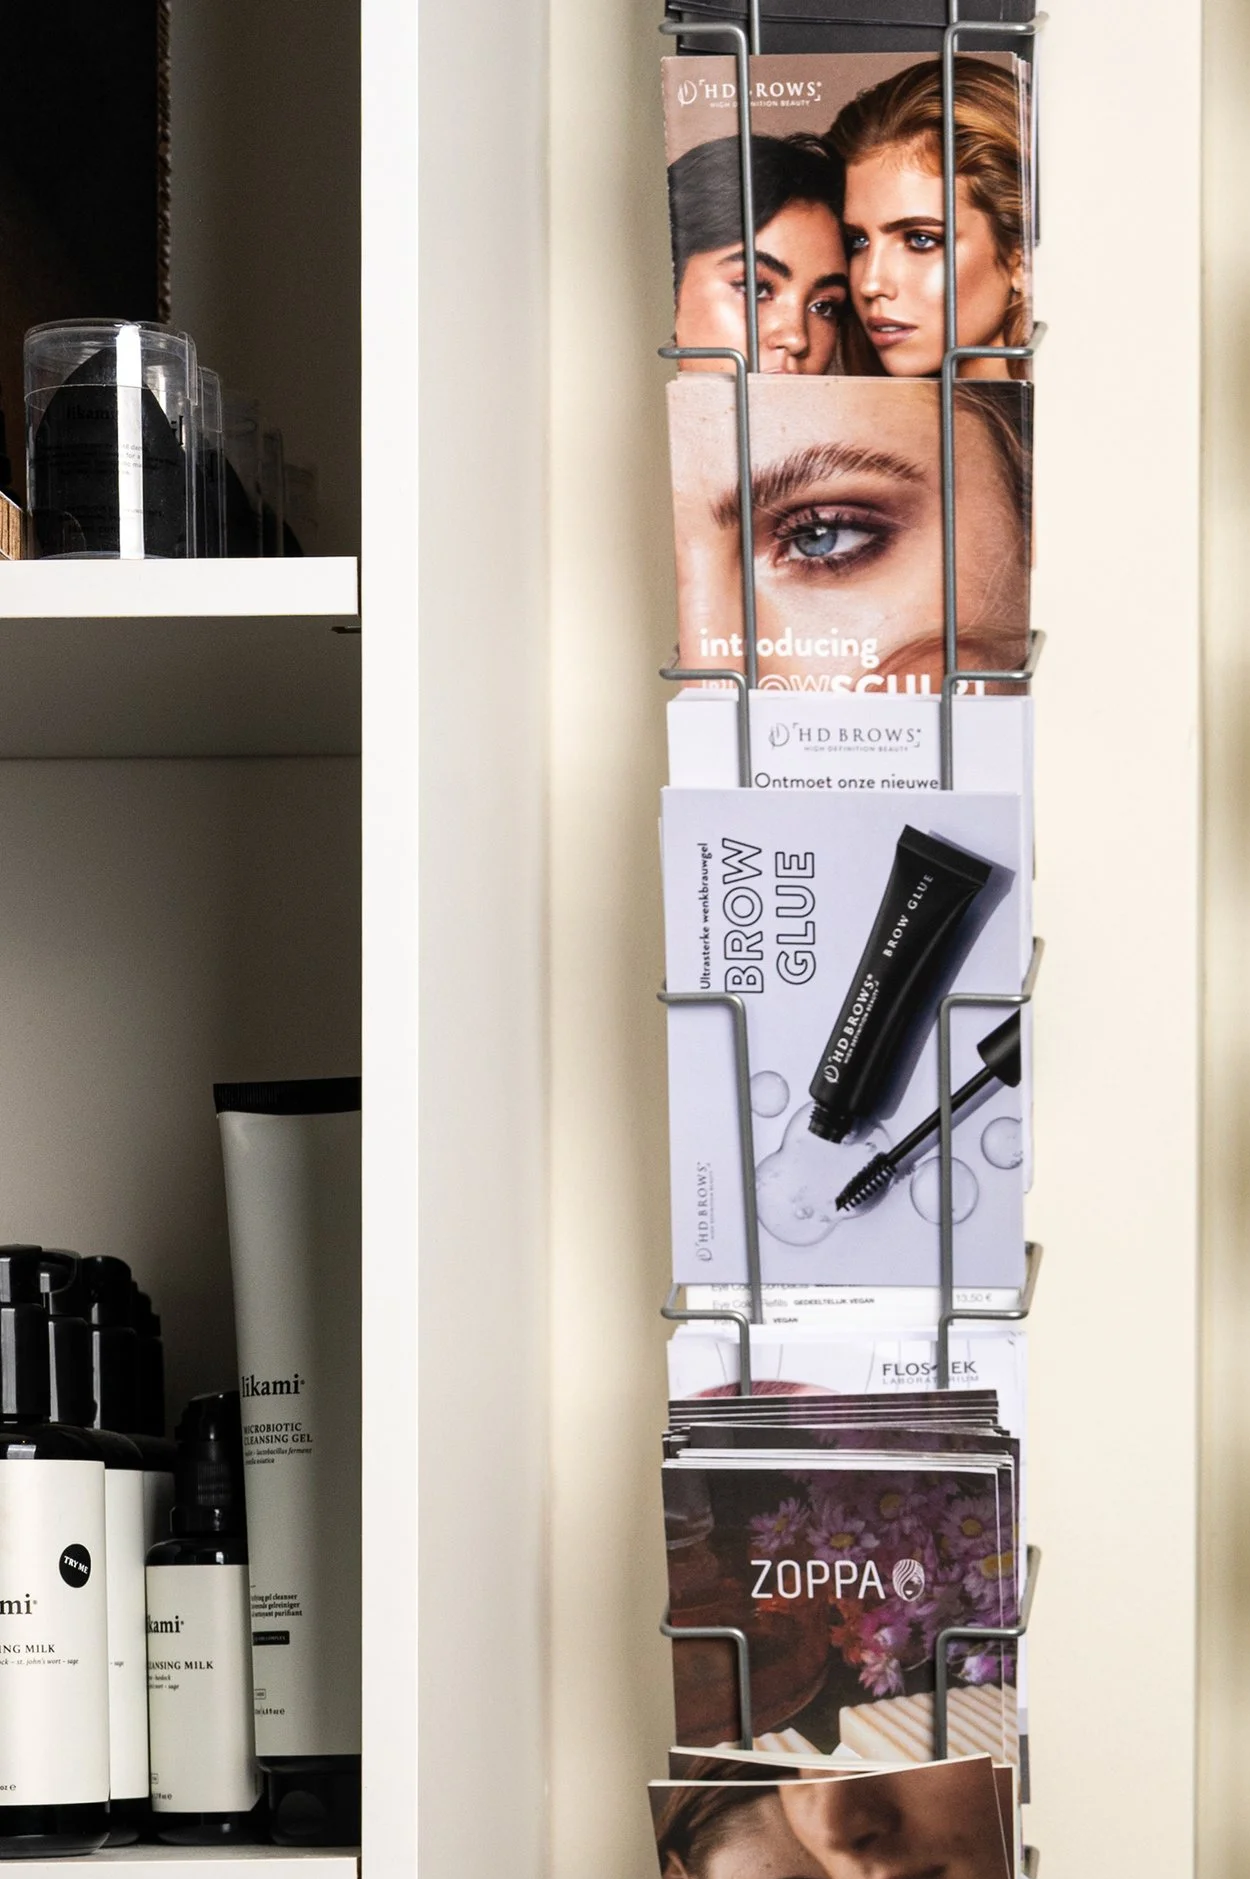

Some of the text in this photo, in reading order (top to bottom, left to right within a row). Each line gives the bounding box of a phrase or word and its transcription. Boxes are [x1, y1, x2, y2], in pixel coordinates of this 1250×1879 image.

[704, 82, 816, 99] HD ROWS
[699, 626, 880, 669] intoducing
[799, 727, 915, 743] HD BROWS
[754, 772, 939, 789] Ontmoet onze nieuwe
[697, 842, 713, 990] Ultrasterke wenkbrauwgel
[721, 837, 764, 994] BROW
[775, 851, 817, 985] GLUE
[883, 874, 934, 957] BROW GLUE
[832, 979, 875, 1063] HD BROWS
[241, 1373, 301, 1398] likami
[291, 1433, 313, 1443] GEL
[63, 1555, 89, 1575] TRY ME
[750, 1558, 886, 1600] ZOPPA
[25, 1644, 56, 1654] MILK
[184, 1661, 214, 1670] MILK
